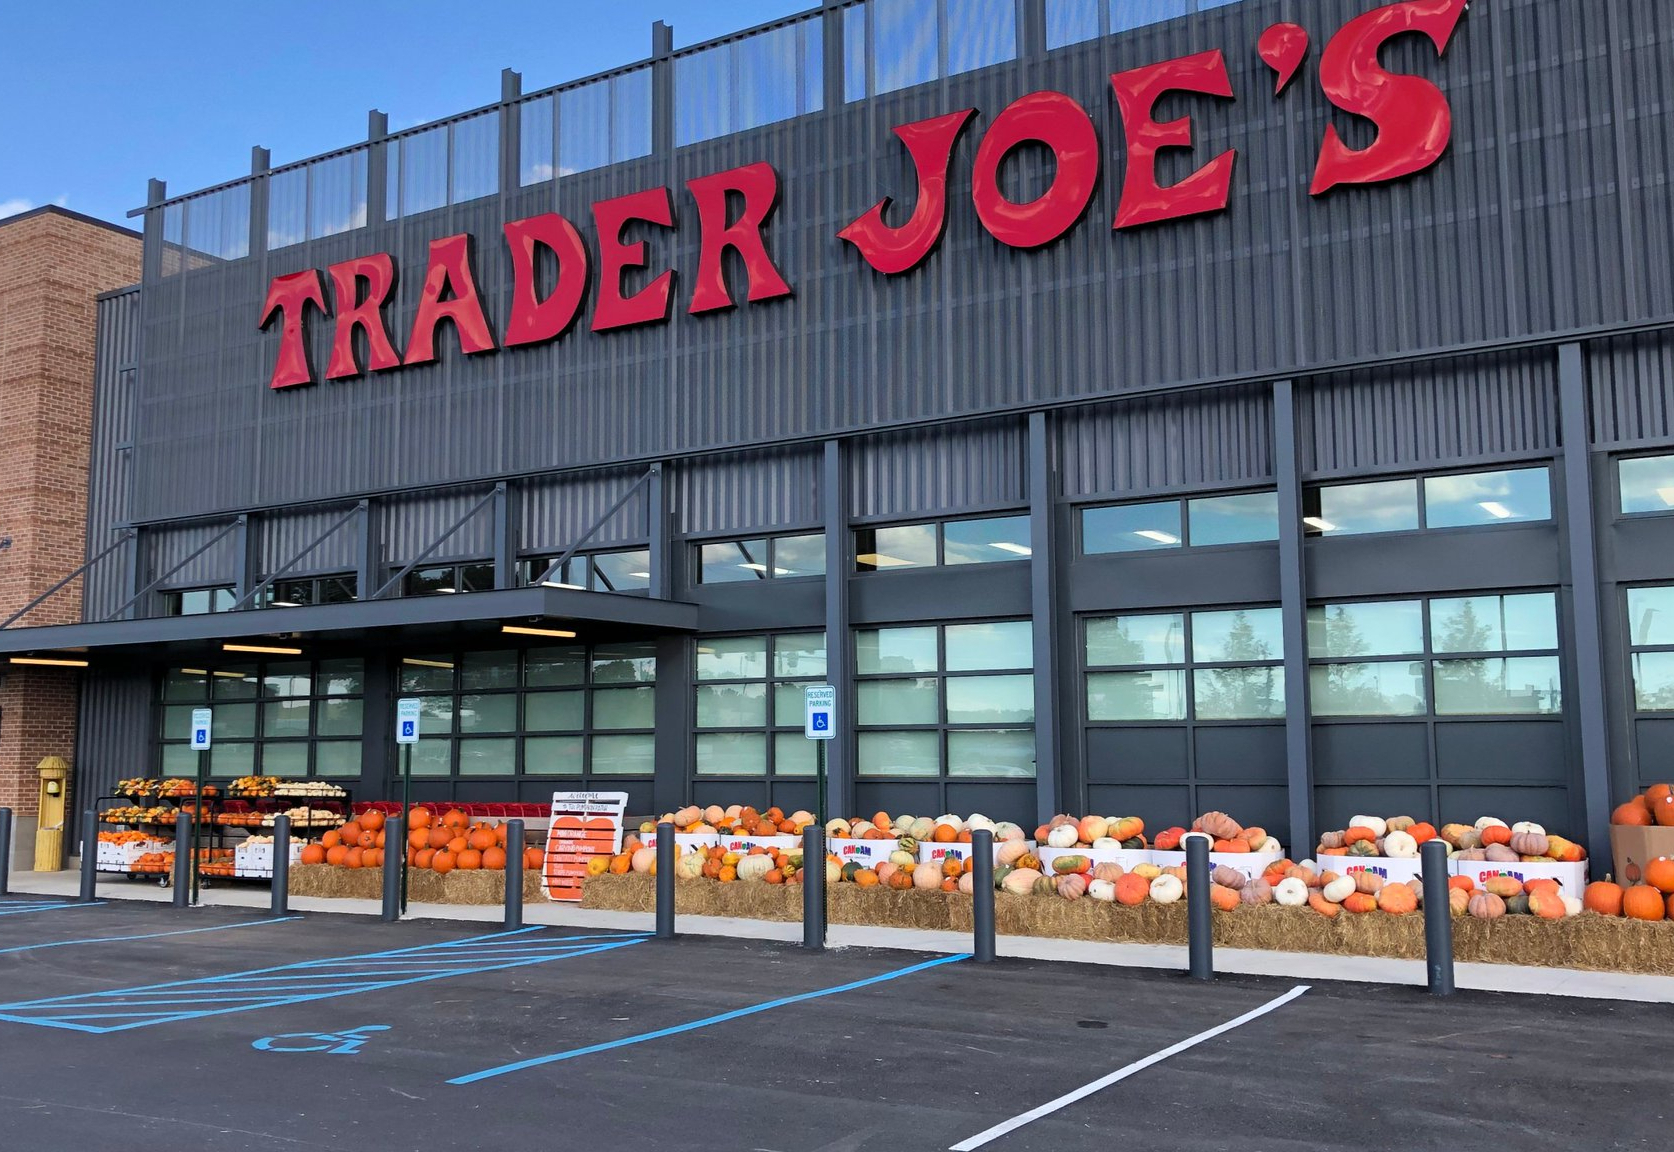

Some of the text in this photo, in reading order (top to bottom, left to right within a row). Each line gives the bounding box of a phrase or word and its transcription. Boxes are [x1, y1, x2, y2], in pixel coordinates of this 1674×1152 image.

[259, 0, 1468, 390] TRADER JOE'S
[807, 690, 833, 698] RESERVED
